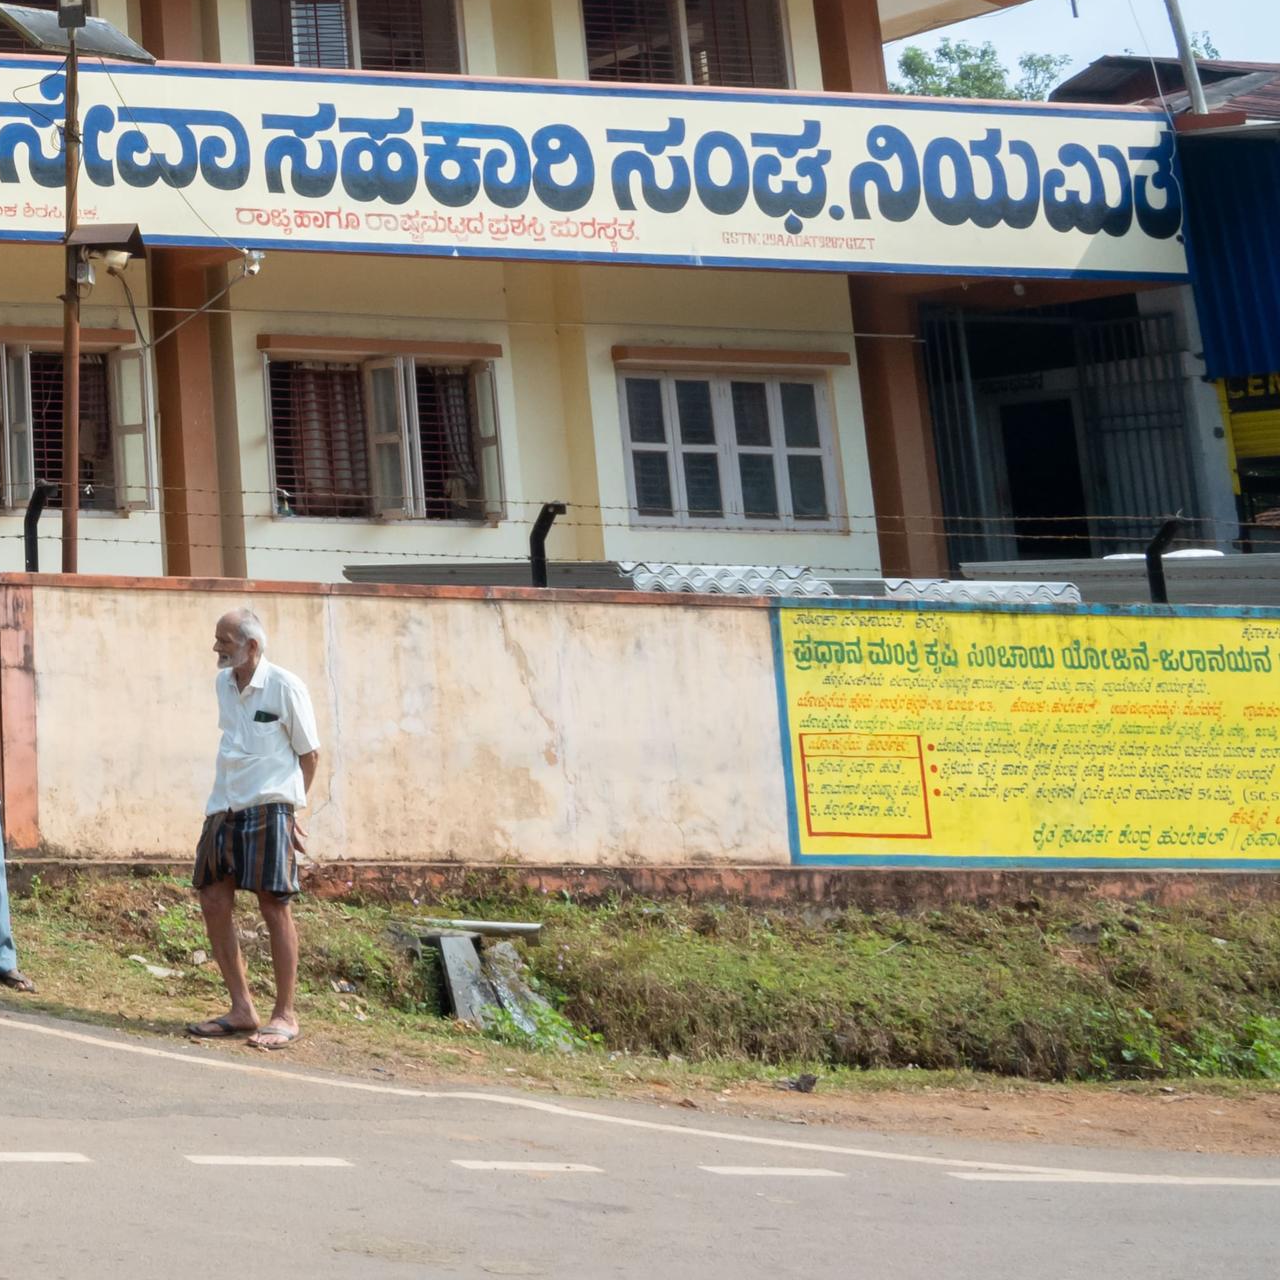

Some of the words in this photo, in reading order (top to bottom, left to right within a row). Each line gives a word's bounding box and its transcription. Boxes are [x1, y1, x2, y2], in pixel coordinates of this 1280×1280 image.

[262, 102, 596, 212] ಸಹಕಾರಿ
[793, 634, 864, 671] ಪ್ರಧಾನ
[867, 636, 921, 673] ಮಂತ್ರಿ
[924, 637, 959, 674] ಕೃಷಿ
